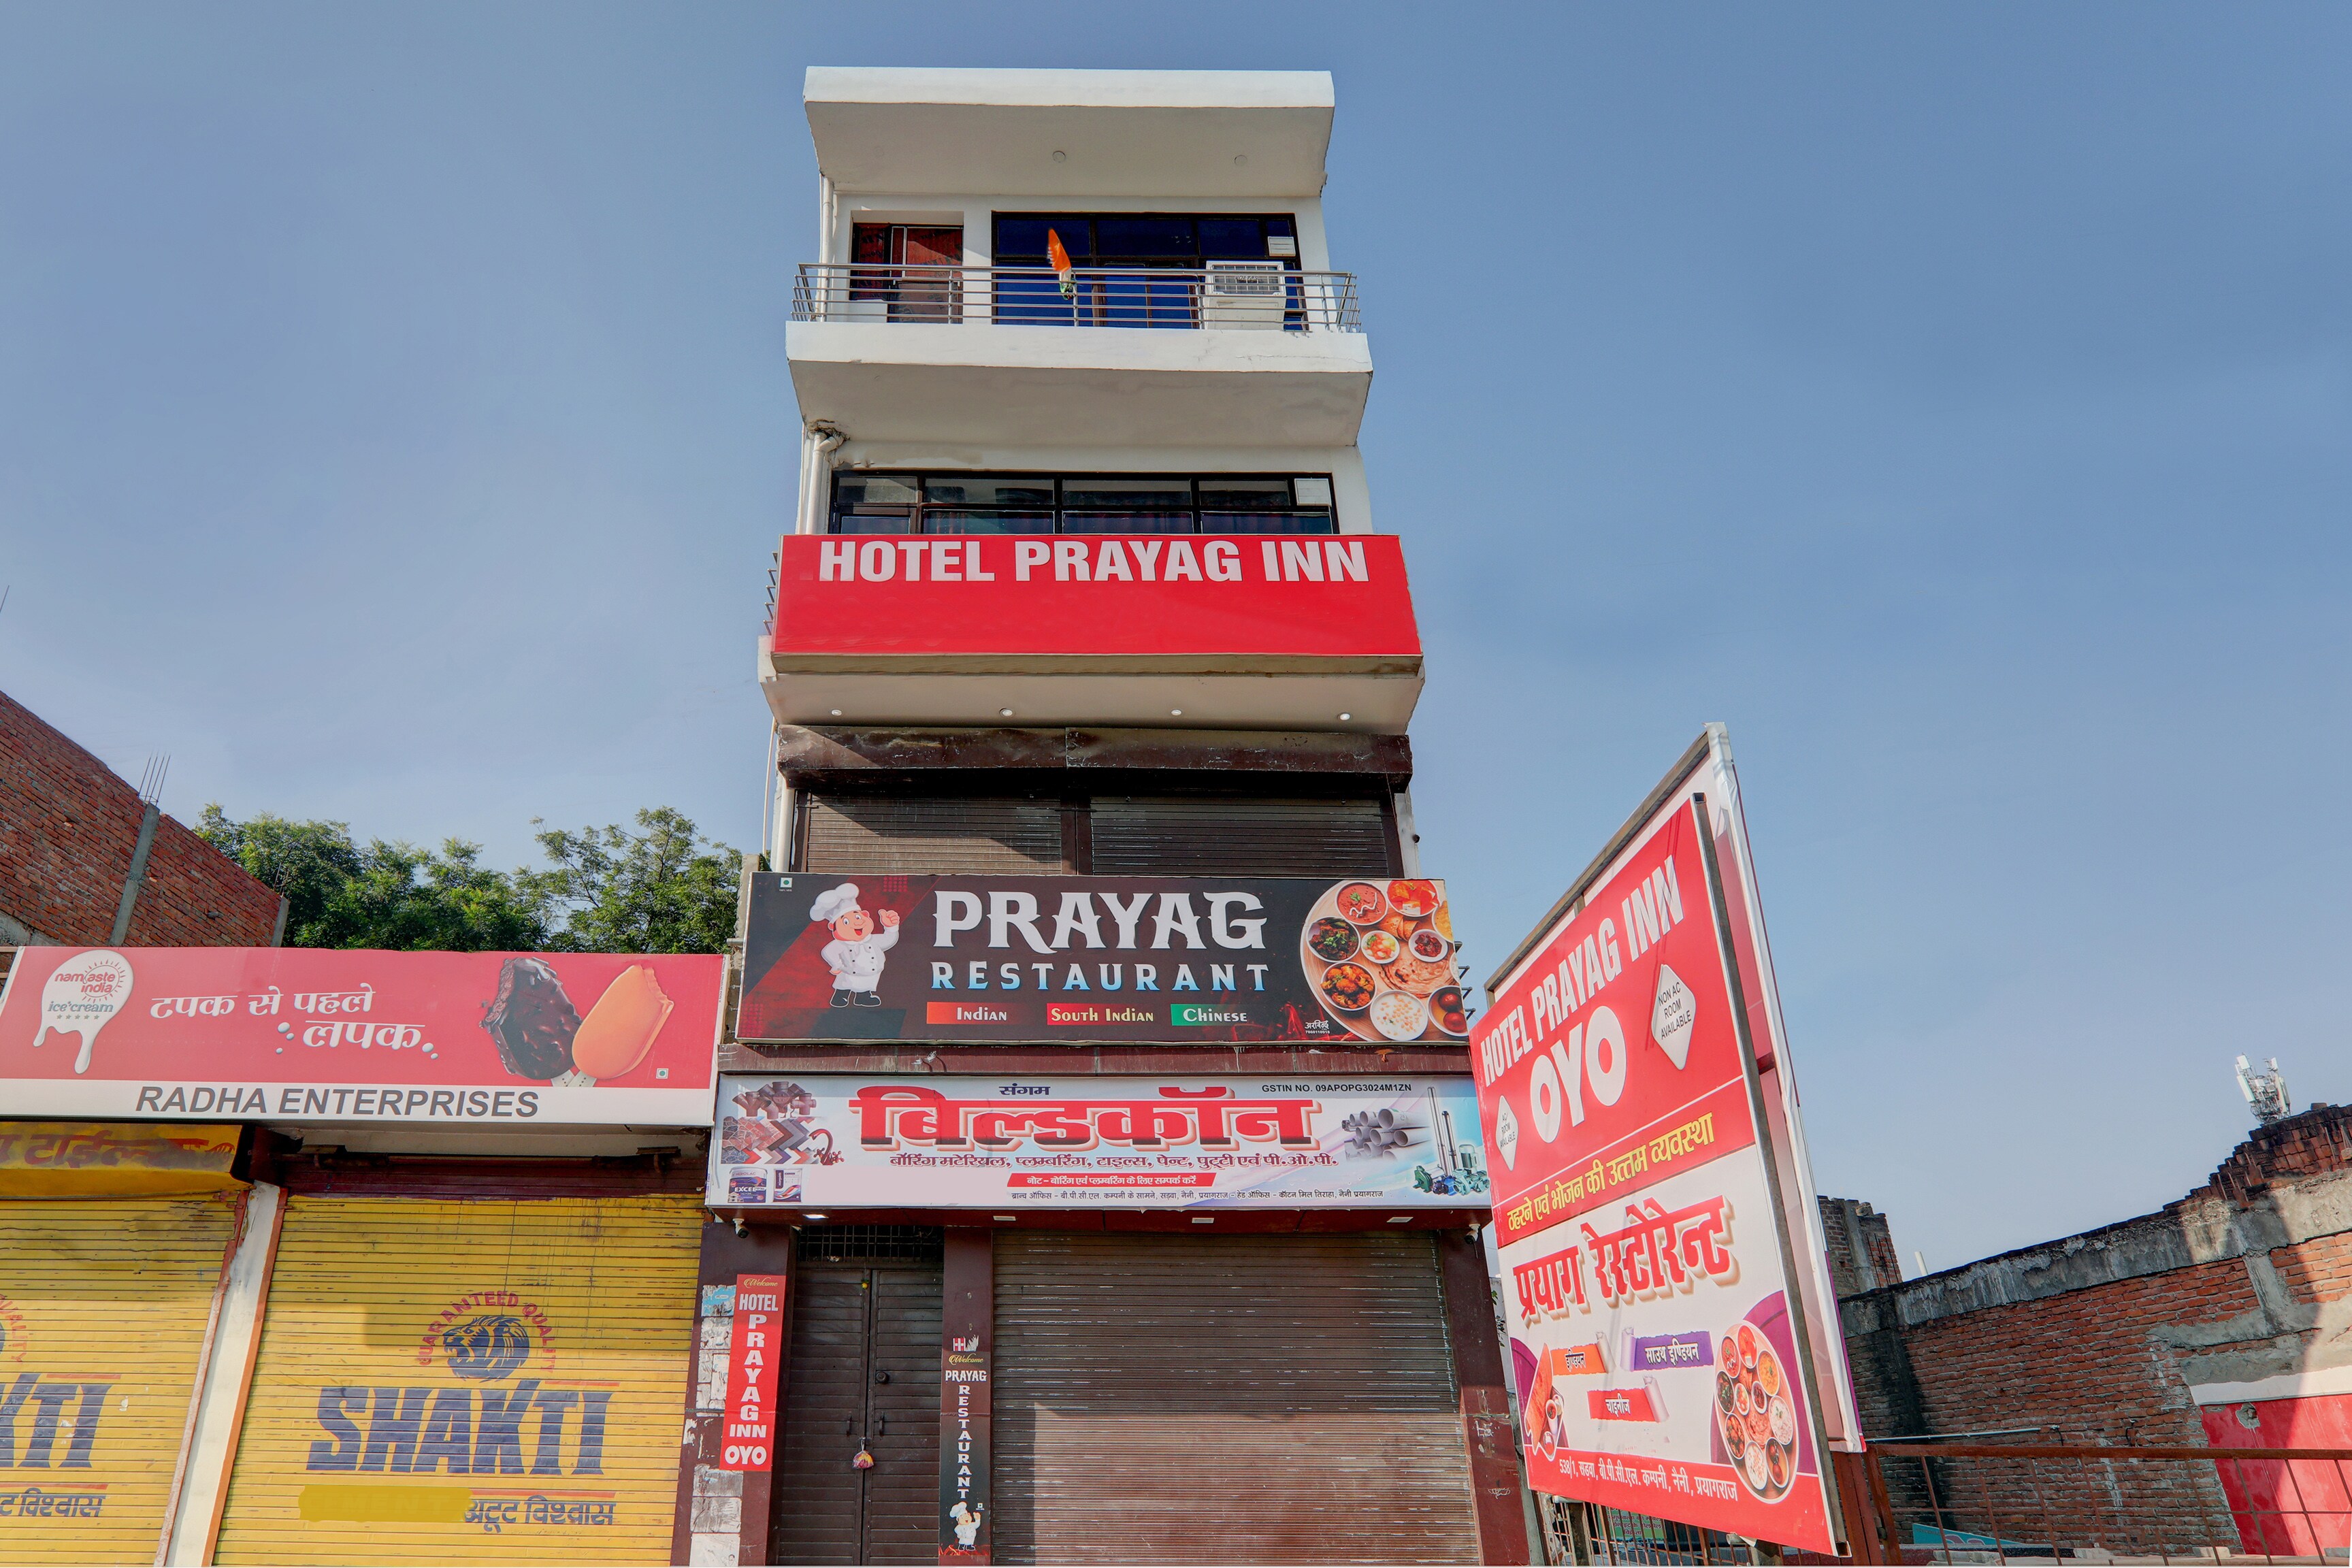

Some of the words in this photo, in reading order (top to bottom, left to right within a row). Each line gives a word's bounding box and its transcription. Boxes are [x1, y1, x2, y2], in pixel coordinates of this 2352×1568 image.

[819, 540, 995, 582] HOTEL
[1015, 540, 1242, 583] PRAYAG
[1262, 540, 1369, 582] INN
[934, 890, 1267, 953] PRAYAG
[54, 972, 116, 982] namaste
[931, 960, 1270, 991] RESTAURANT
[1481, 1004, 1533, 1087] HOTEL
[1531, 917, 1622, 1042] PRAYAG
[1622, 855, 1684, 962] INN
[81, 982, 113, 993] india
[150, 995, 237, 1019] टपक
[248, 985, 284, 1015] से
[293, 983, 375, 1014] पहले
[1659, 988, 1671, 1007] NON
[1672, 982, 1681, 997] AC
[1664, 998, 1682, 1019] ROOM
[1661, 1010, 1691, 1040] AVAILABLE
[1530, 1006, 1627, 1143] OYO
[135, 1085, 267, 1114] RADHA
[278, 1088, 539, 1117] ENTERPRISES
[998, 1083, 1051, 1096] संगम
[1027, 1177, 1043, 1185] नोट
[1137, 1176, 1153, 1185] लिए
[1507, 1196, 1534, 1232] ठहरने
[1533, 1183, 1550, 1220] एवं
[1551, 1181, 1584, 1211] भोजन
[1584, 1159, 1605, 1194] की
[1606, 1145, 1648, 1186] उत्तम
[1649, 1112, 1715, 1164] व्यवस्था
[744, 1277, 779, 1288] Welcome
[1512, 1245, 1587, 1324] प्रयाग
[739, 1294, 779, 1311] HOTEL
[416, 1290, 519, 1366] GUARANTEED
[520, 1302, 557, 1373] QUALITY
[740, 1314, 768, 1421] PRAYAG
[949, 1353, 983, 1365] Welcome
[1644, 1345, 1667, 1364] साउथ
[945, 1370, 987, 1382] PRAYAG
[306, 1380, 614, 1475] SHAKTI
[730, 1424, 766, 1438] INN
[724, 1446, 767, 1465] OYO
[18, 1488, 106, 1517] विश्वास
[1694, 1476, 1738, 1501] प्रयागराज
[523, 1494, 617, 1524] विश्वास
